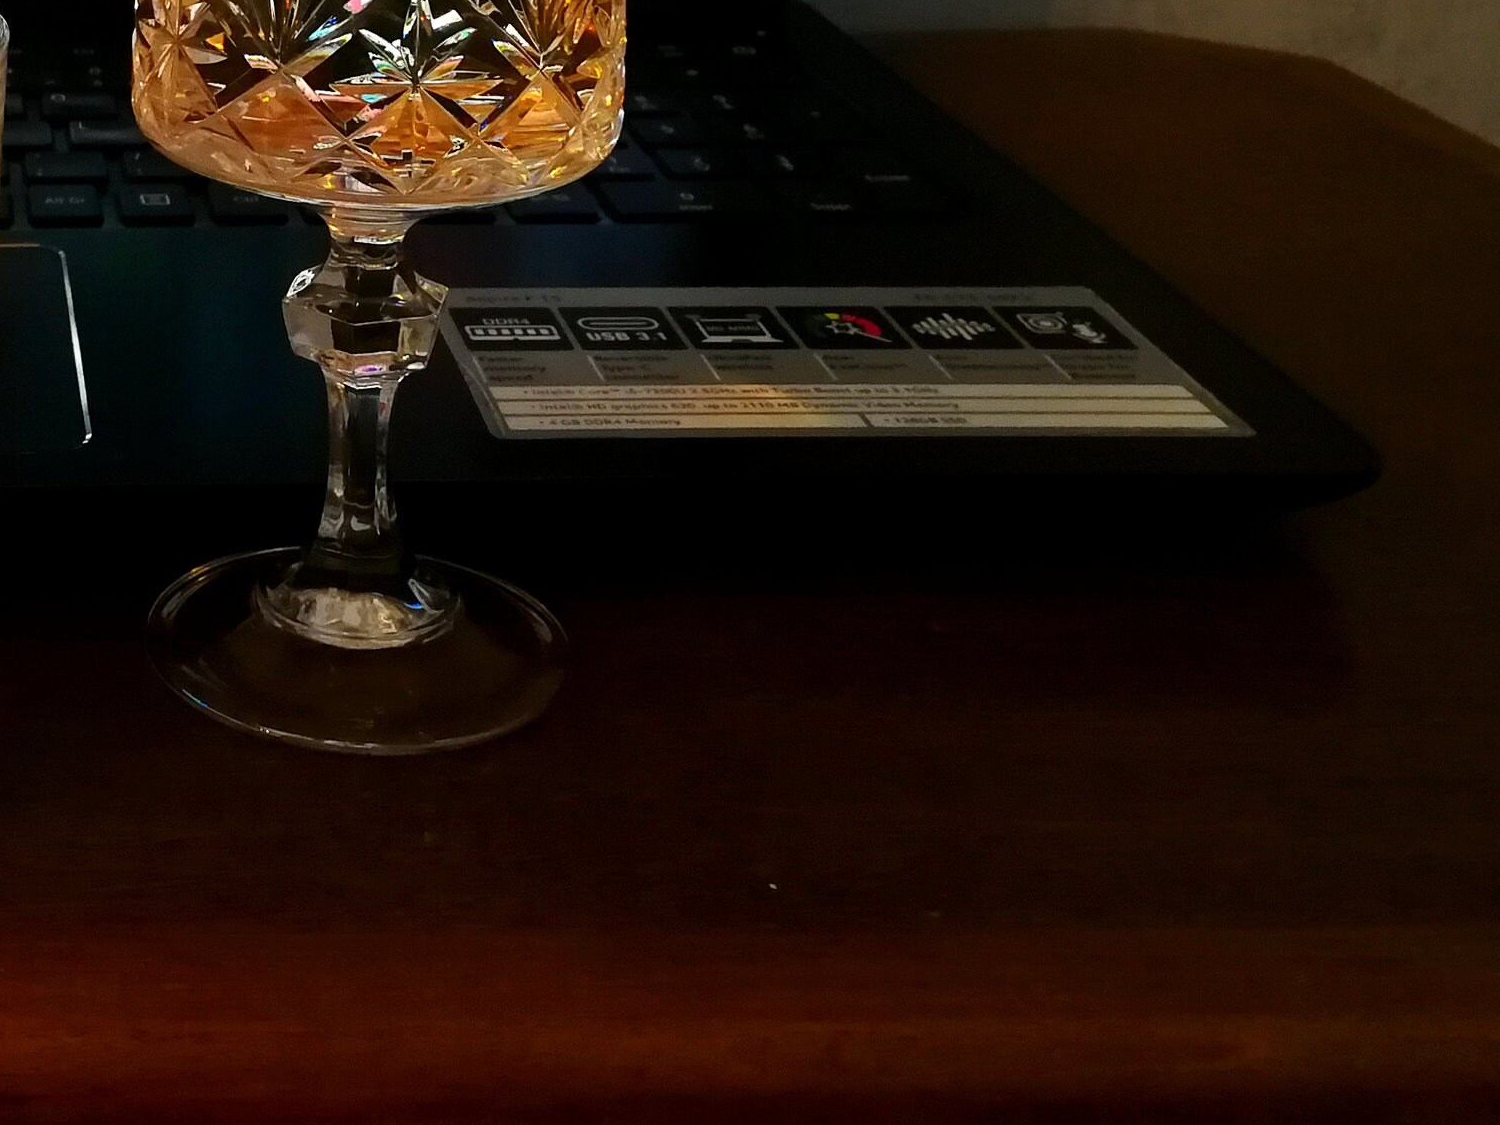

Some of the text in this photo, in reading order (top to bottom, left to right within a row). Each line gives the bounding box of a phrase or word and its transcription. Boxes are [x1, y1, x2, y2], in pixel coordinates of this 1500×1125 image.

[482, 317, 530, 325] DDR4
[585, 331, 668, 342] USB 3.1
[777, 401, 800, 410] MB
